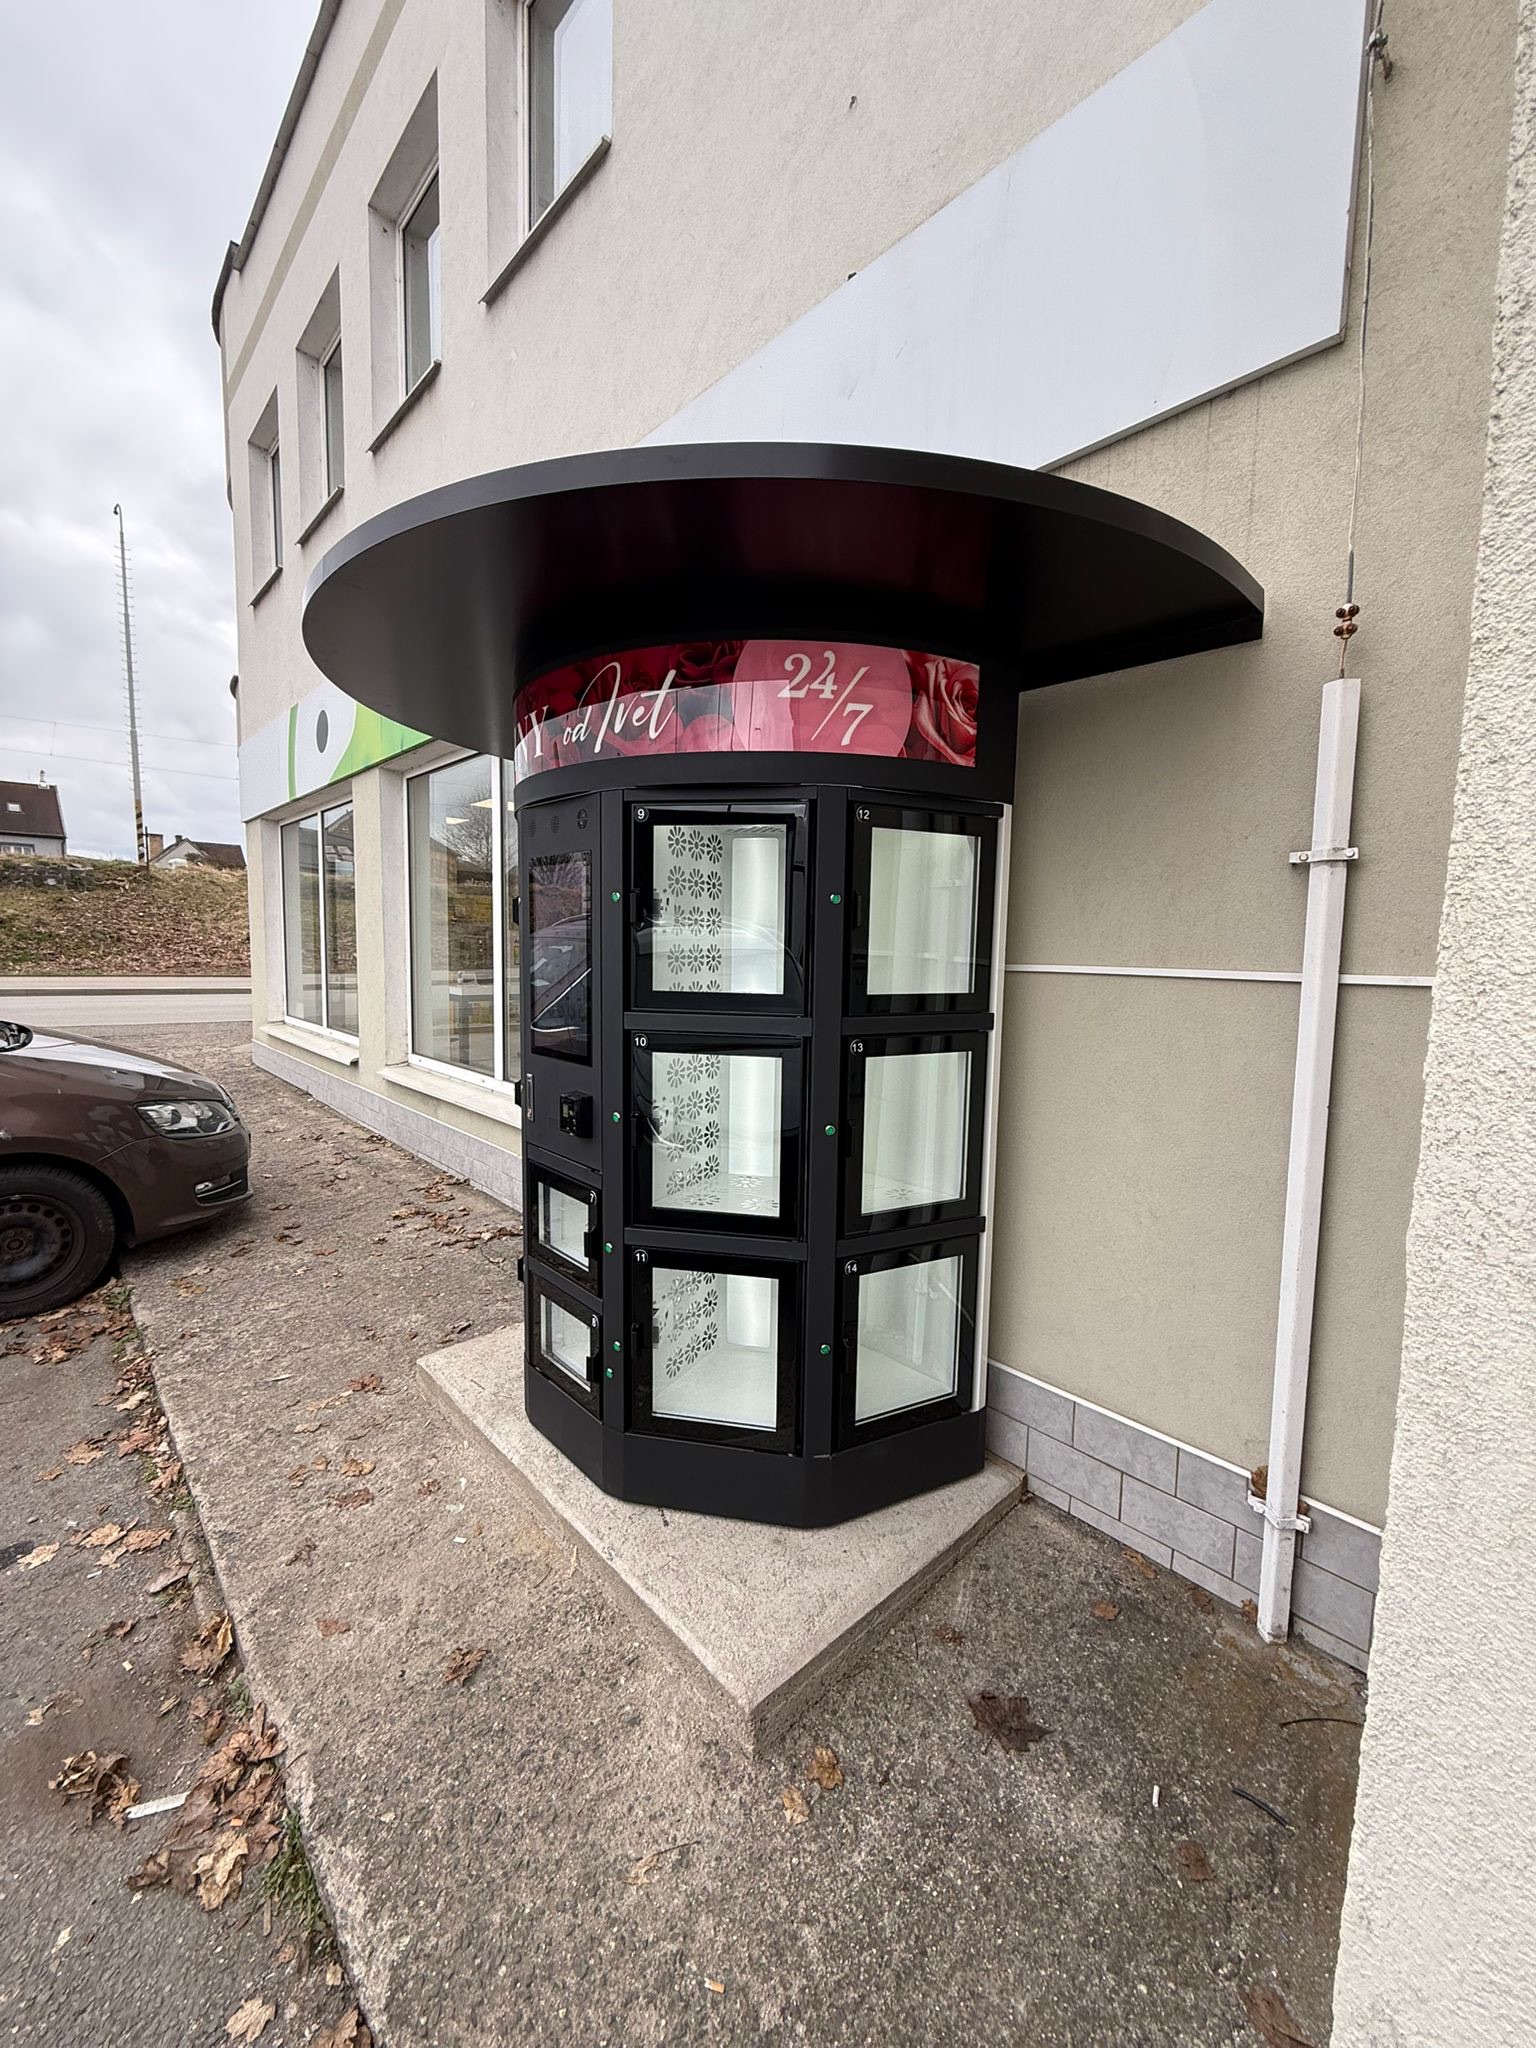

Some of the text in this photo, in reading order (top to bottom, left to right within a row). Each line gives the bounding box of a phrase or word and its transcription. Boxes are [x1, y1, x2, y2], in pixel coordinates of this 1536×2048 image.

[777, 650, 873, 746] 24/7
[577, 661, 692, 754] Ivet
[563, 704, 592, 746] od
[637, 808, 645, 820] 9
[858, 809, 870, 820] 12
[634, 1037, 647, 1047] 10
[852, 1043, 864, 1053] 13
[635, 1253, 646, 1262] 11
[847, 1263, 858, 1274] 14
